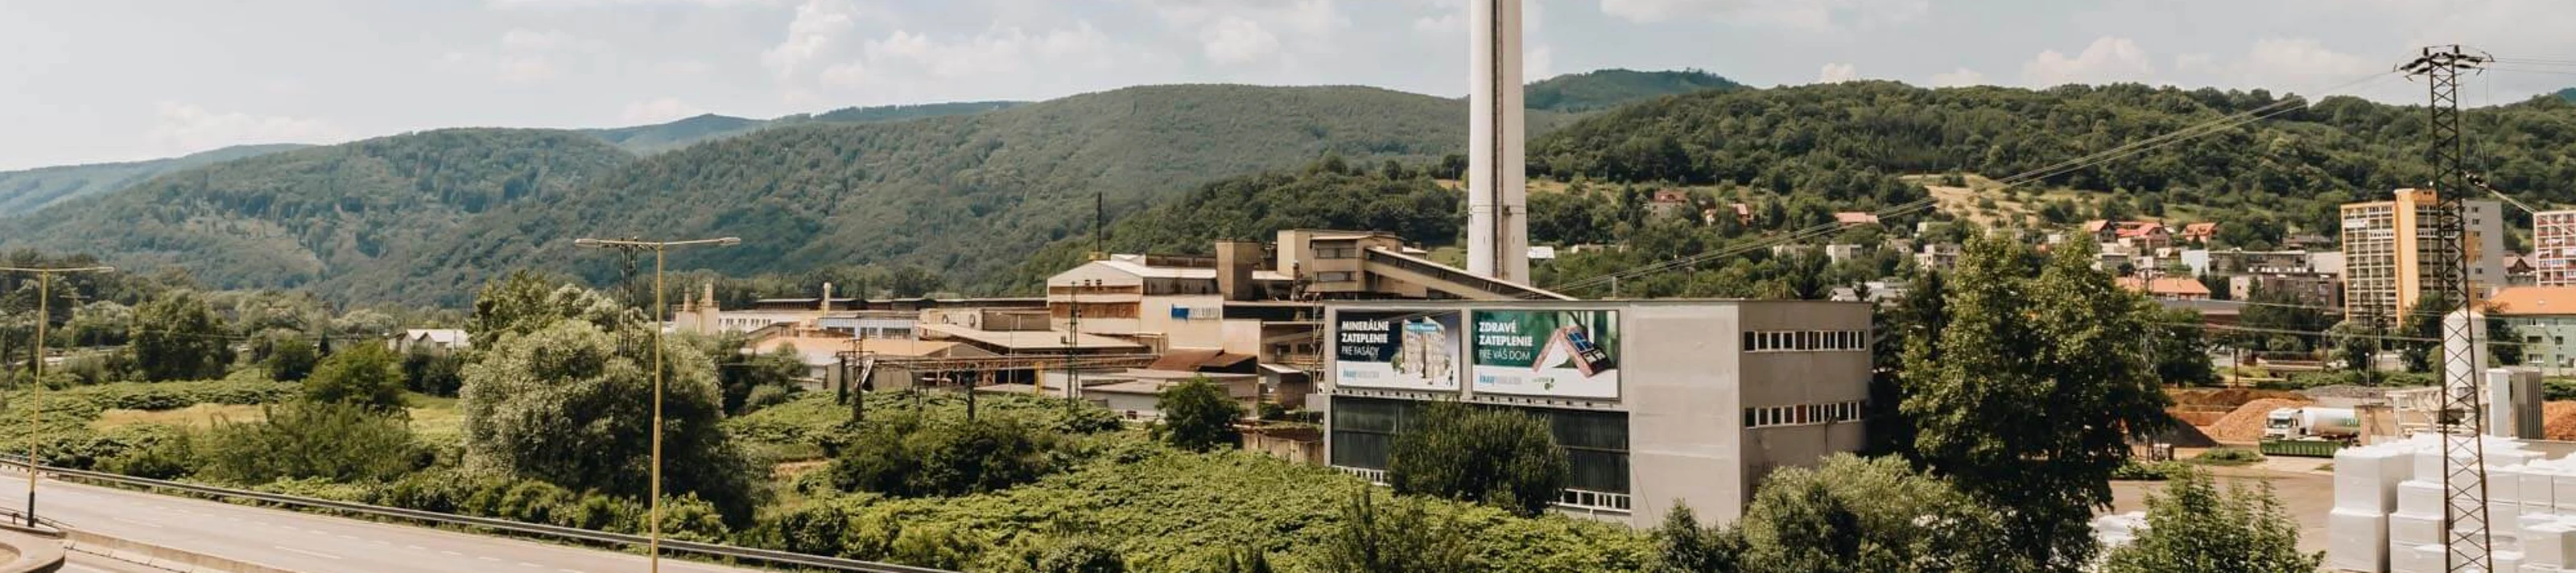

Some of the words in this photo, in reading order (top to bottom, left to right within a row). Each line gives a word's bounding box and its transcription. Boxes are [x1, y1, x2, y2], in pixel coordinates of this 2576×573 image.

[1341, 319, 1389, 332] MINERÁLNE
[1479, 319, 1517, 332] ZDRAVÉ
[1341, 333, 1389, 344] ZATEPLENIE
[1479, 336, 1533, 347] ZATEPLENIE
[1341, 346, 1353, 355] PRE
[1479, 348, 1492, 359] PRE
[1493, 348, 1509, 360] VÁŠ
[1509, 350, 1530, 361] DOM
